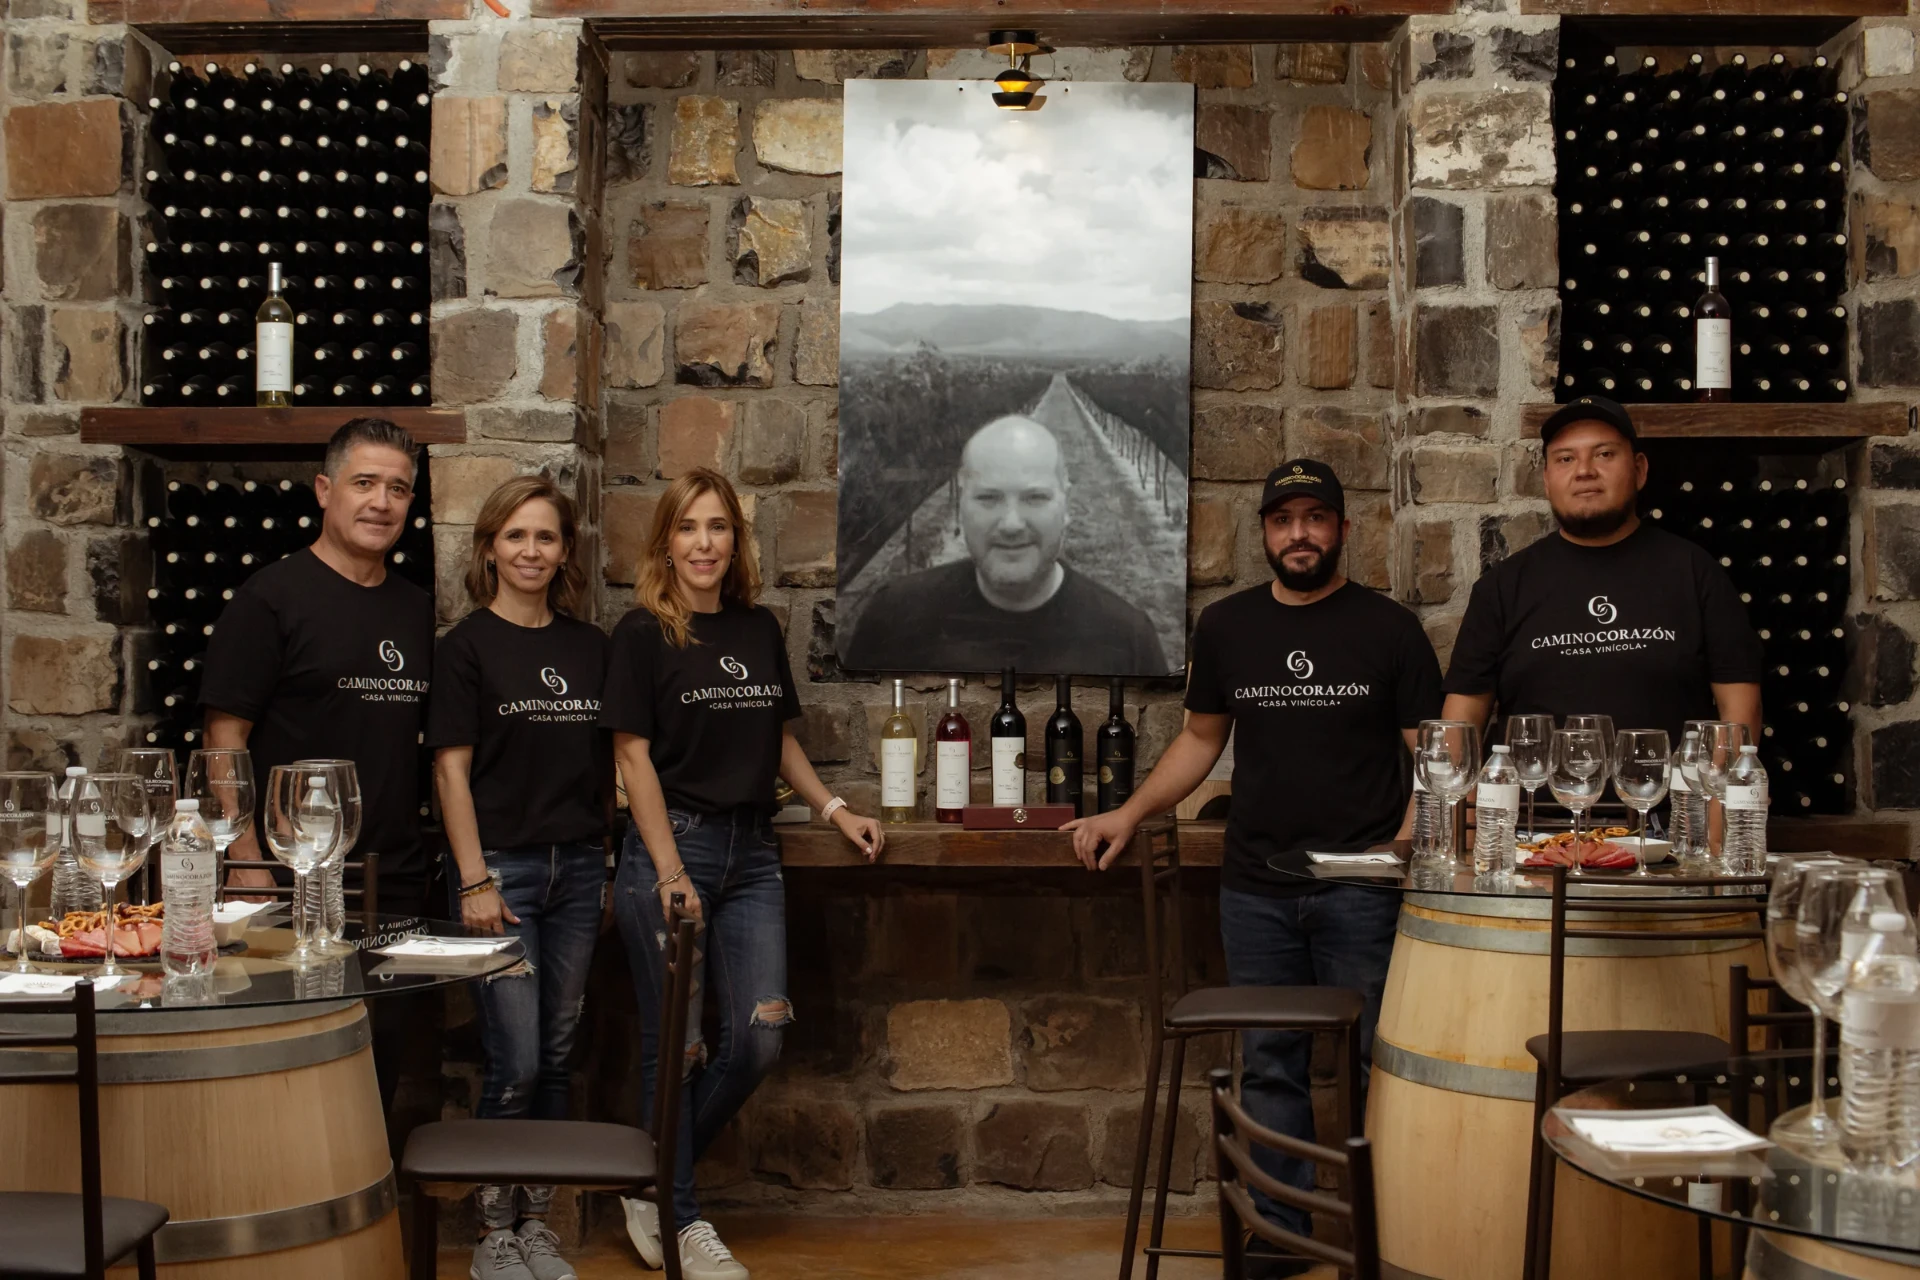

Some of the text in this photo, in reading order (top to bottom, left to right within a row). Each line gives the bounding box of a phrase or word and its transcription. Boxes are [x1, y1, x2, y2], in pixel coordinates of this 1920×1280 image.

[1531, 627, 1676, 649] CAMINOCORAZÓN
[1565, 642, 1642, 656] CASA VINÍCOLA
[337, 677, 430, 693] CAMINOCORAZ
[1234, 682, 1370, 699] CAMINOCORAZÓN
[364, 693, 385, 702] CASA
[681, 684, 783, 704] CAMINOCORAZÓ
[498, 699, 602, 716] CAMINOCORAZ
[712, 700, 773, 710] CASA VINÍCOLA
[1262, 698, 1336, 708] CASA VINÍCOLA
[532, 714, 593, 722] CASA VINÍCOLA
